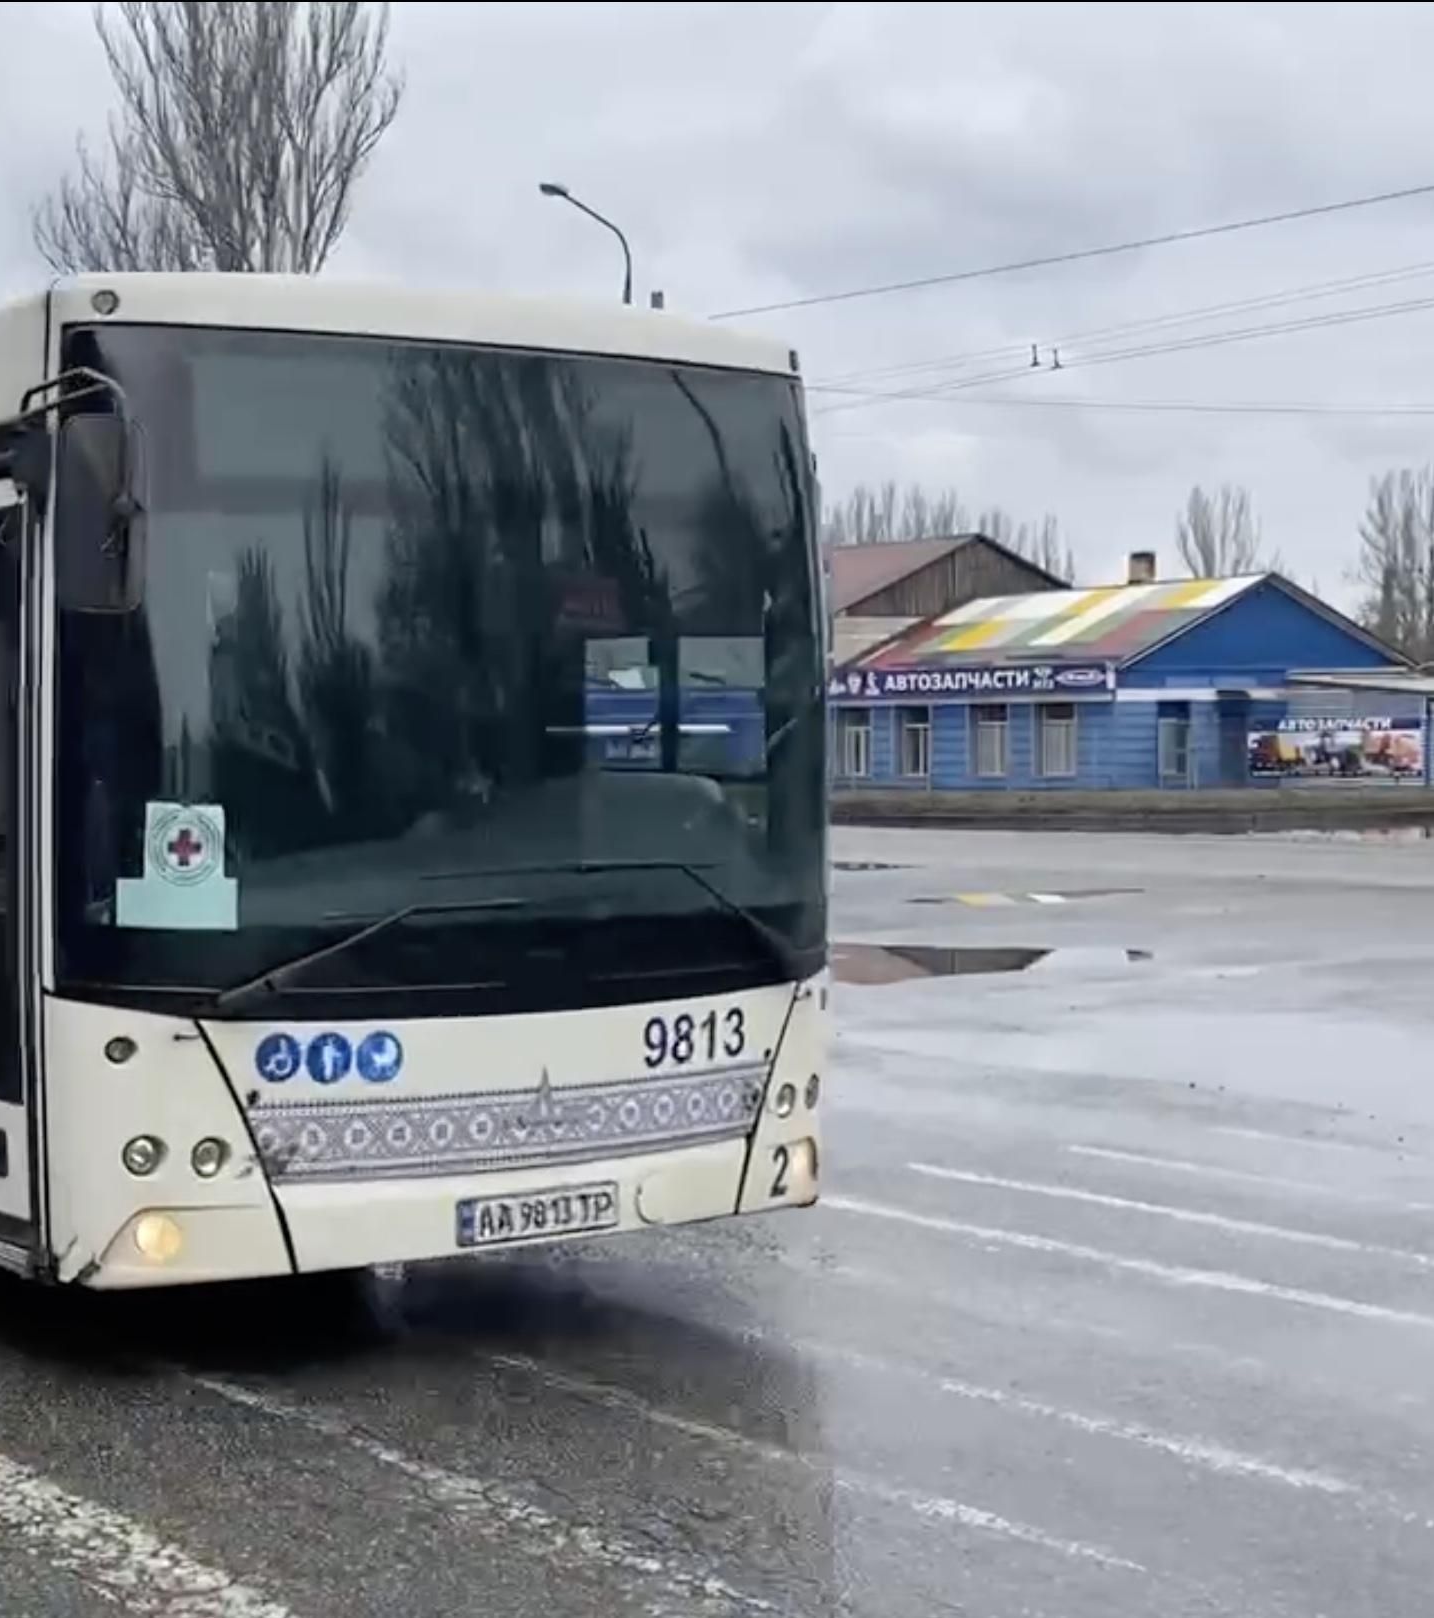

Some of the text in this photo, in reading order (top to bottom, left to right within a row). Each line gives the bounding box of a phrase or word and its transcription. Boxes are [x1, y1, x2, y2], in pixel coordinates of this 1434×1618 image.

[884, 670, 1029, 691] АВТОЗАПЧАСТИ
[1277, 718, 1392, 730] АВТОЗАПЧАСТИ
[644, 1007, 744, 1068] 9813
[770, 1145, 788, 1197] 2
